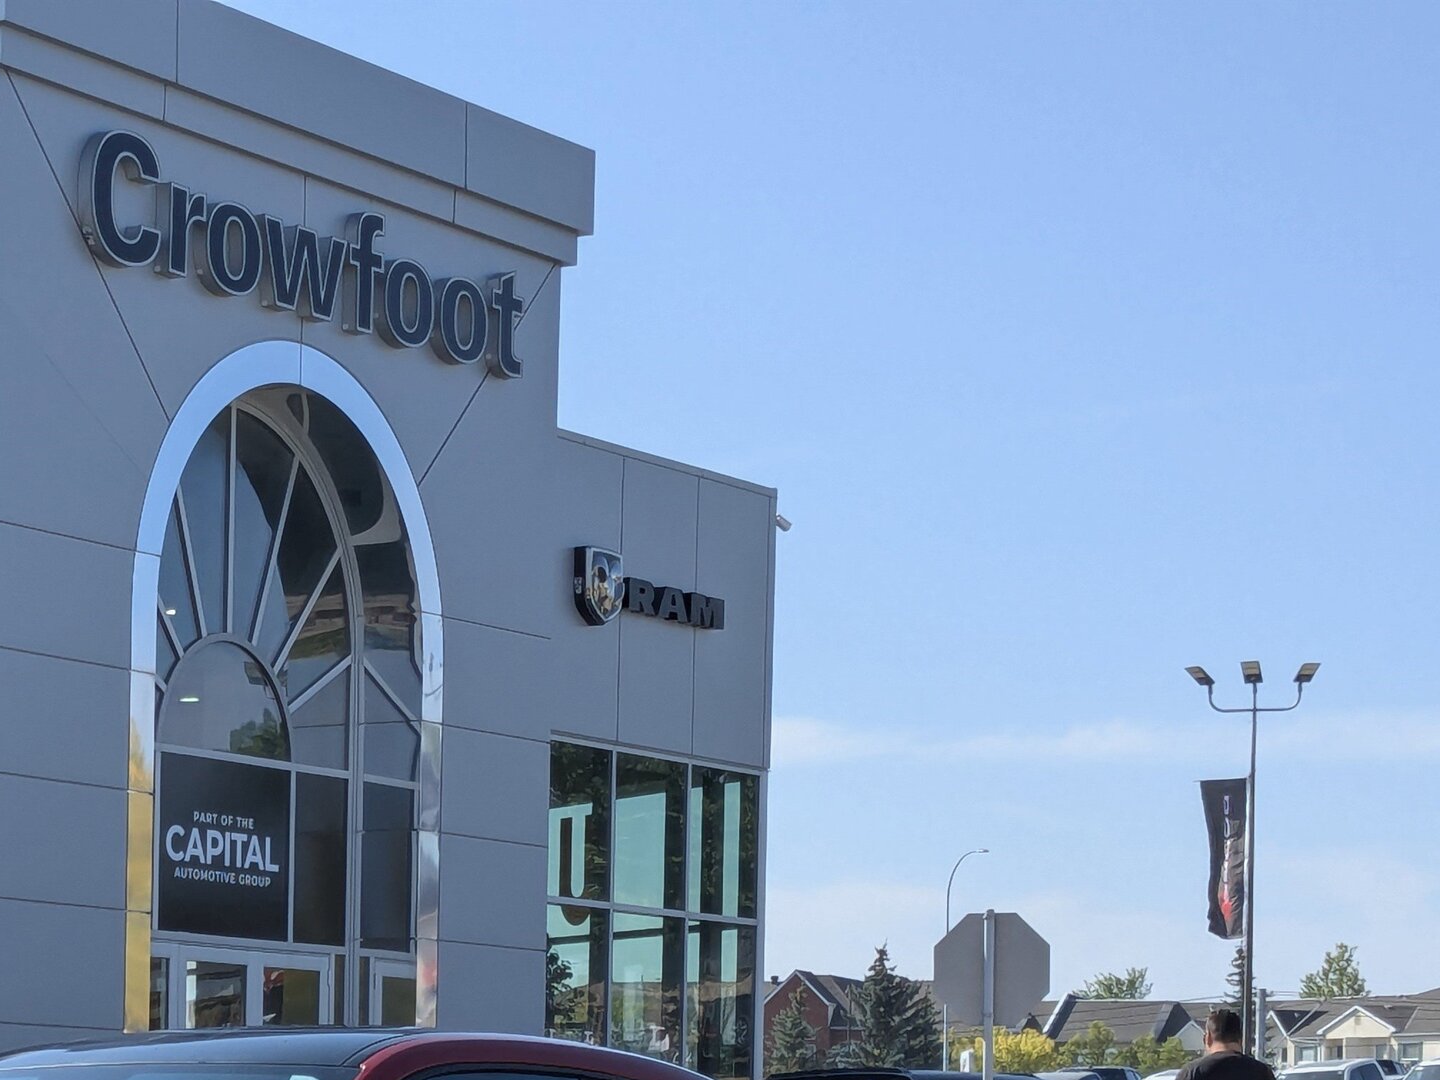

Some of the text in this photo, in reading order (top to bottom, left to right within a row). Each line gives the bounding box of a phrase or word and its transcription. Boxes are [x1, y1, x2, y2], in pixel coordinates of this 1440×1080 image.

[91, 130, 523, 378] Crowfoot
[628, 576, 725, 630] RAM
[193, 811, 255, 830] PART OF THE
[165, 824, 280, 873] CAPITAL
[174, 866, 272, 888] AUTOMOTIVE GROUP
